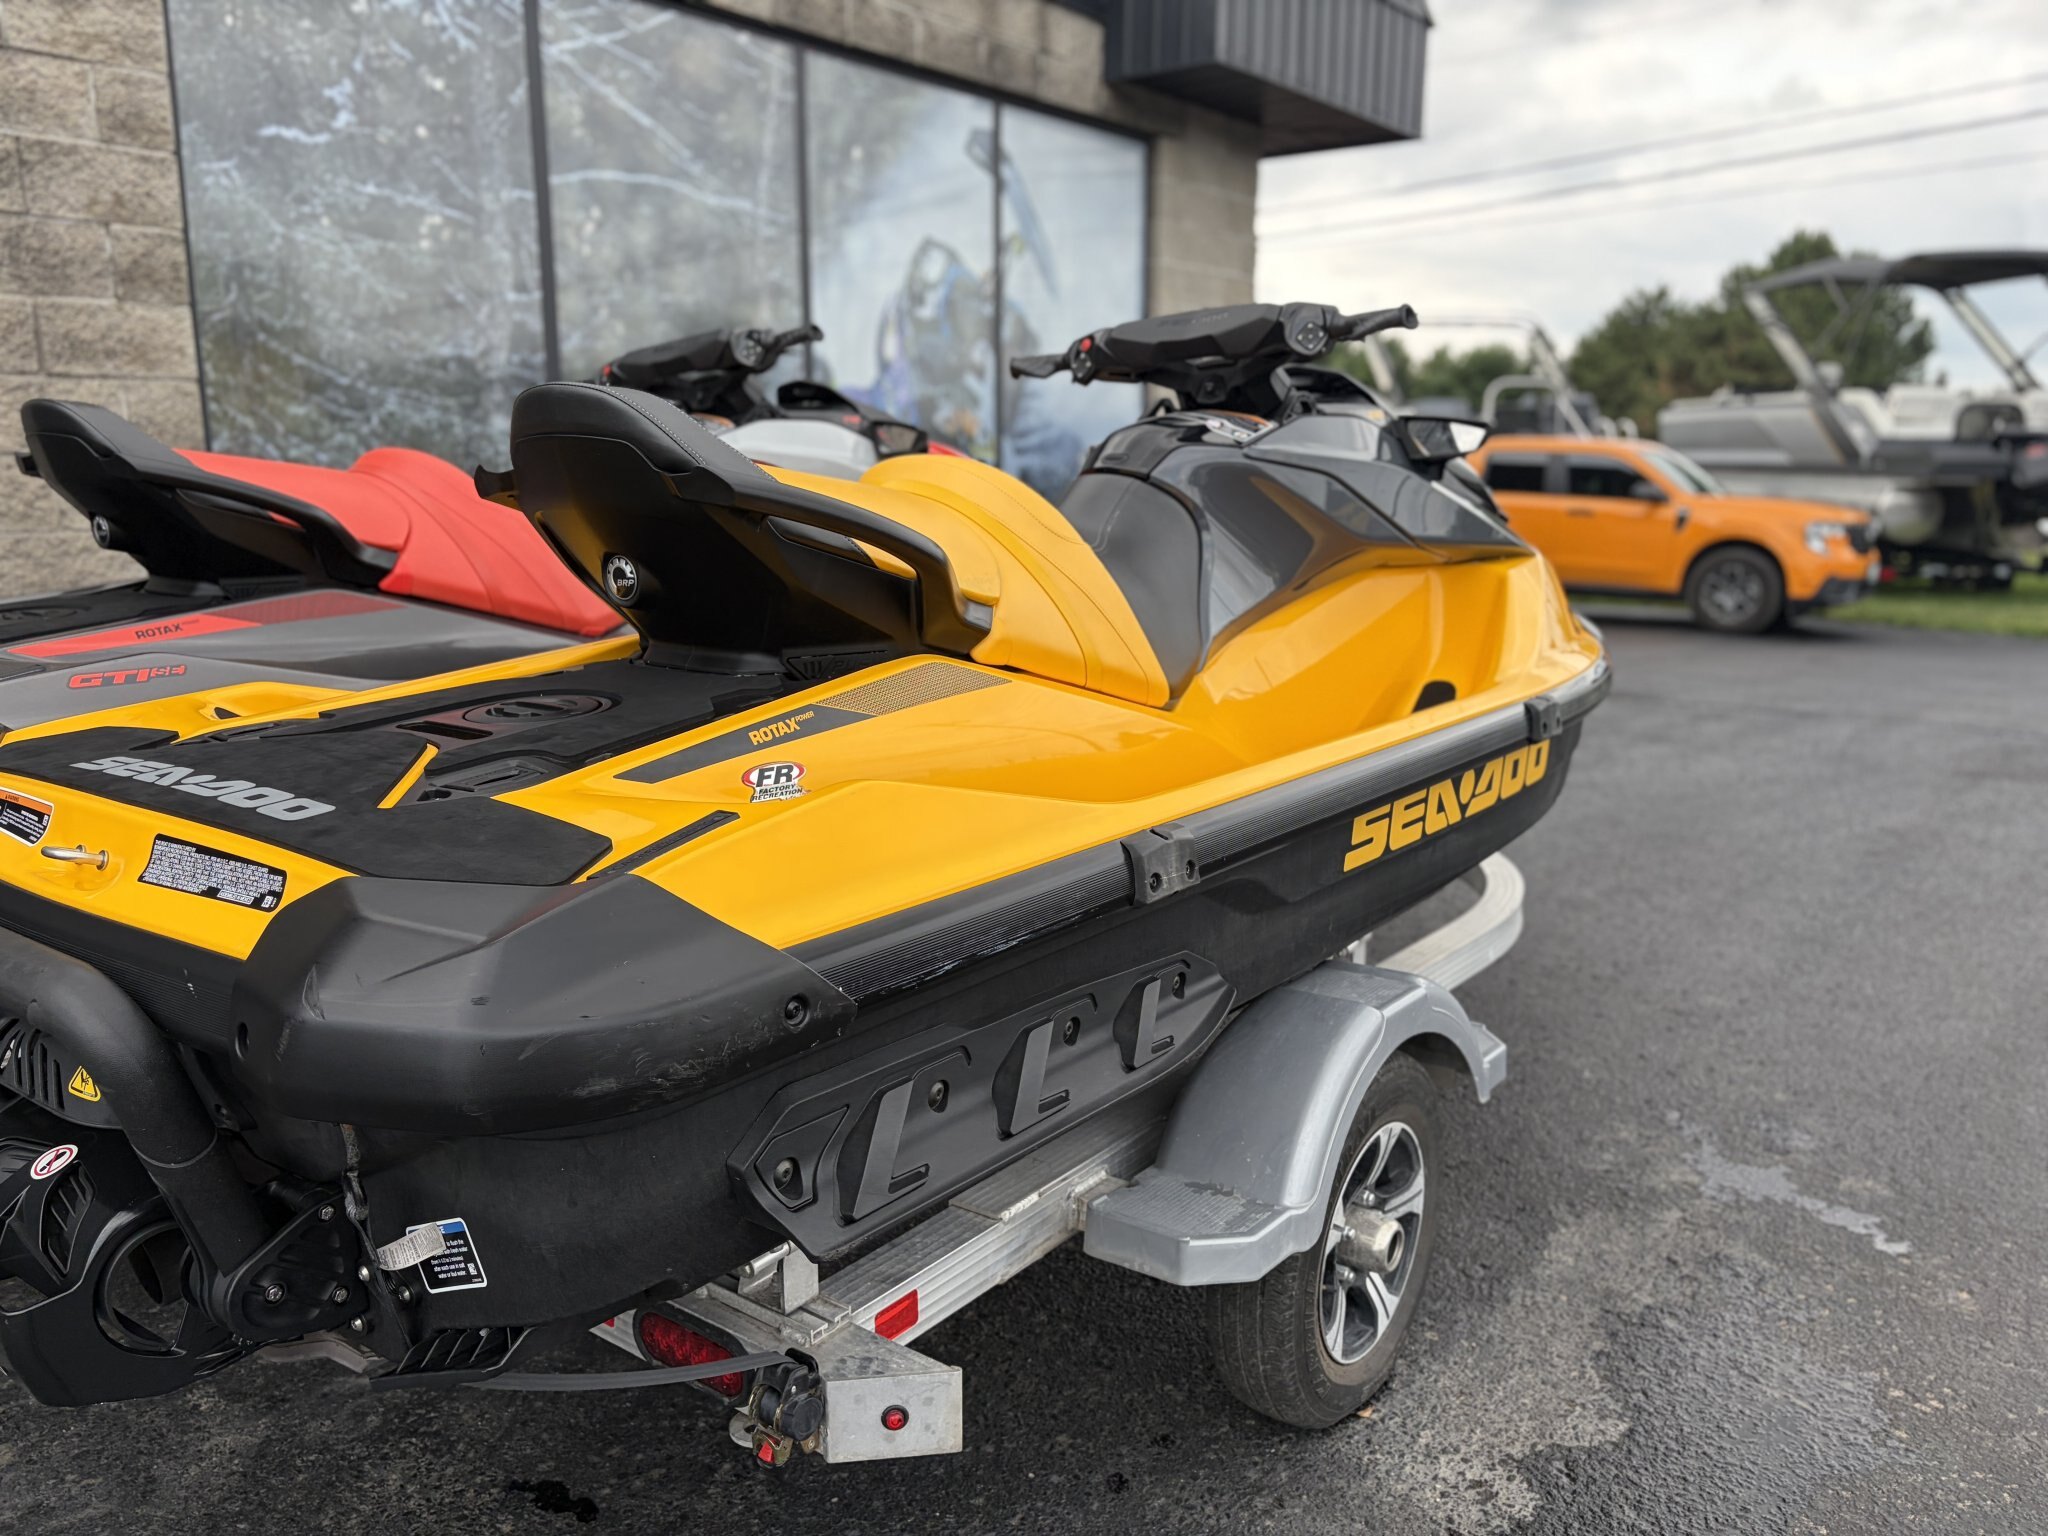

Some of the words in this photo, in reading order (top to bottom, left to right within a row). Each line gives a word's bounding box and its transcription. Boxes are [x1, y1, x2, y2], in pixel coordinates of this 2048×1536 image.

[617, 579, 635, 587] BRP
[135, 623, 183, 640] ROTAX
[69, 668, 150, 688] GTI
[748, 717, 800, 746] ROTAX
[755, 764, 794, 788] FR
[751, 788, 803, 801] RECREATION
[758, 784, 796, 795] FACTORY
